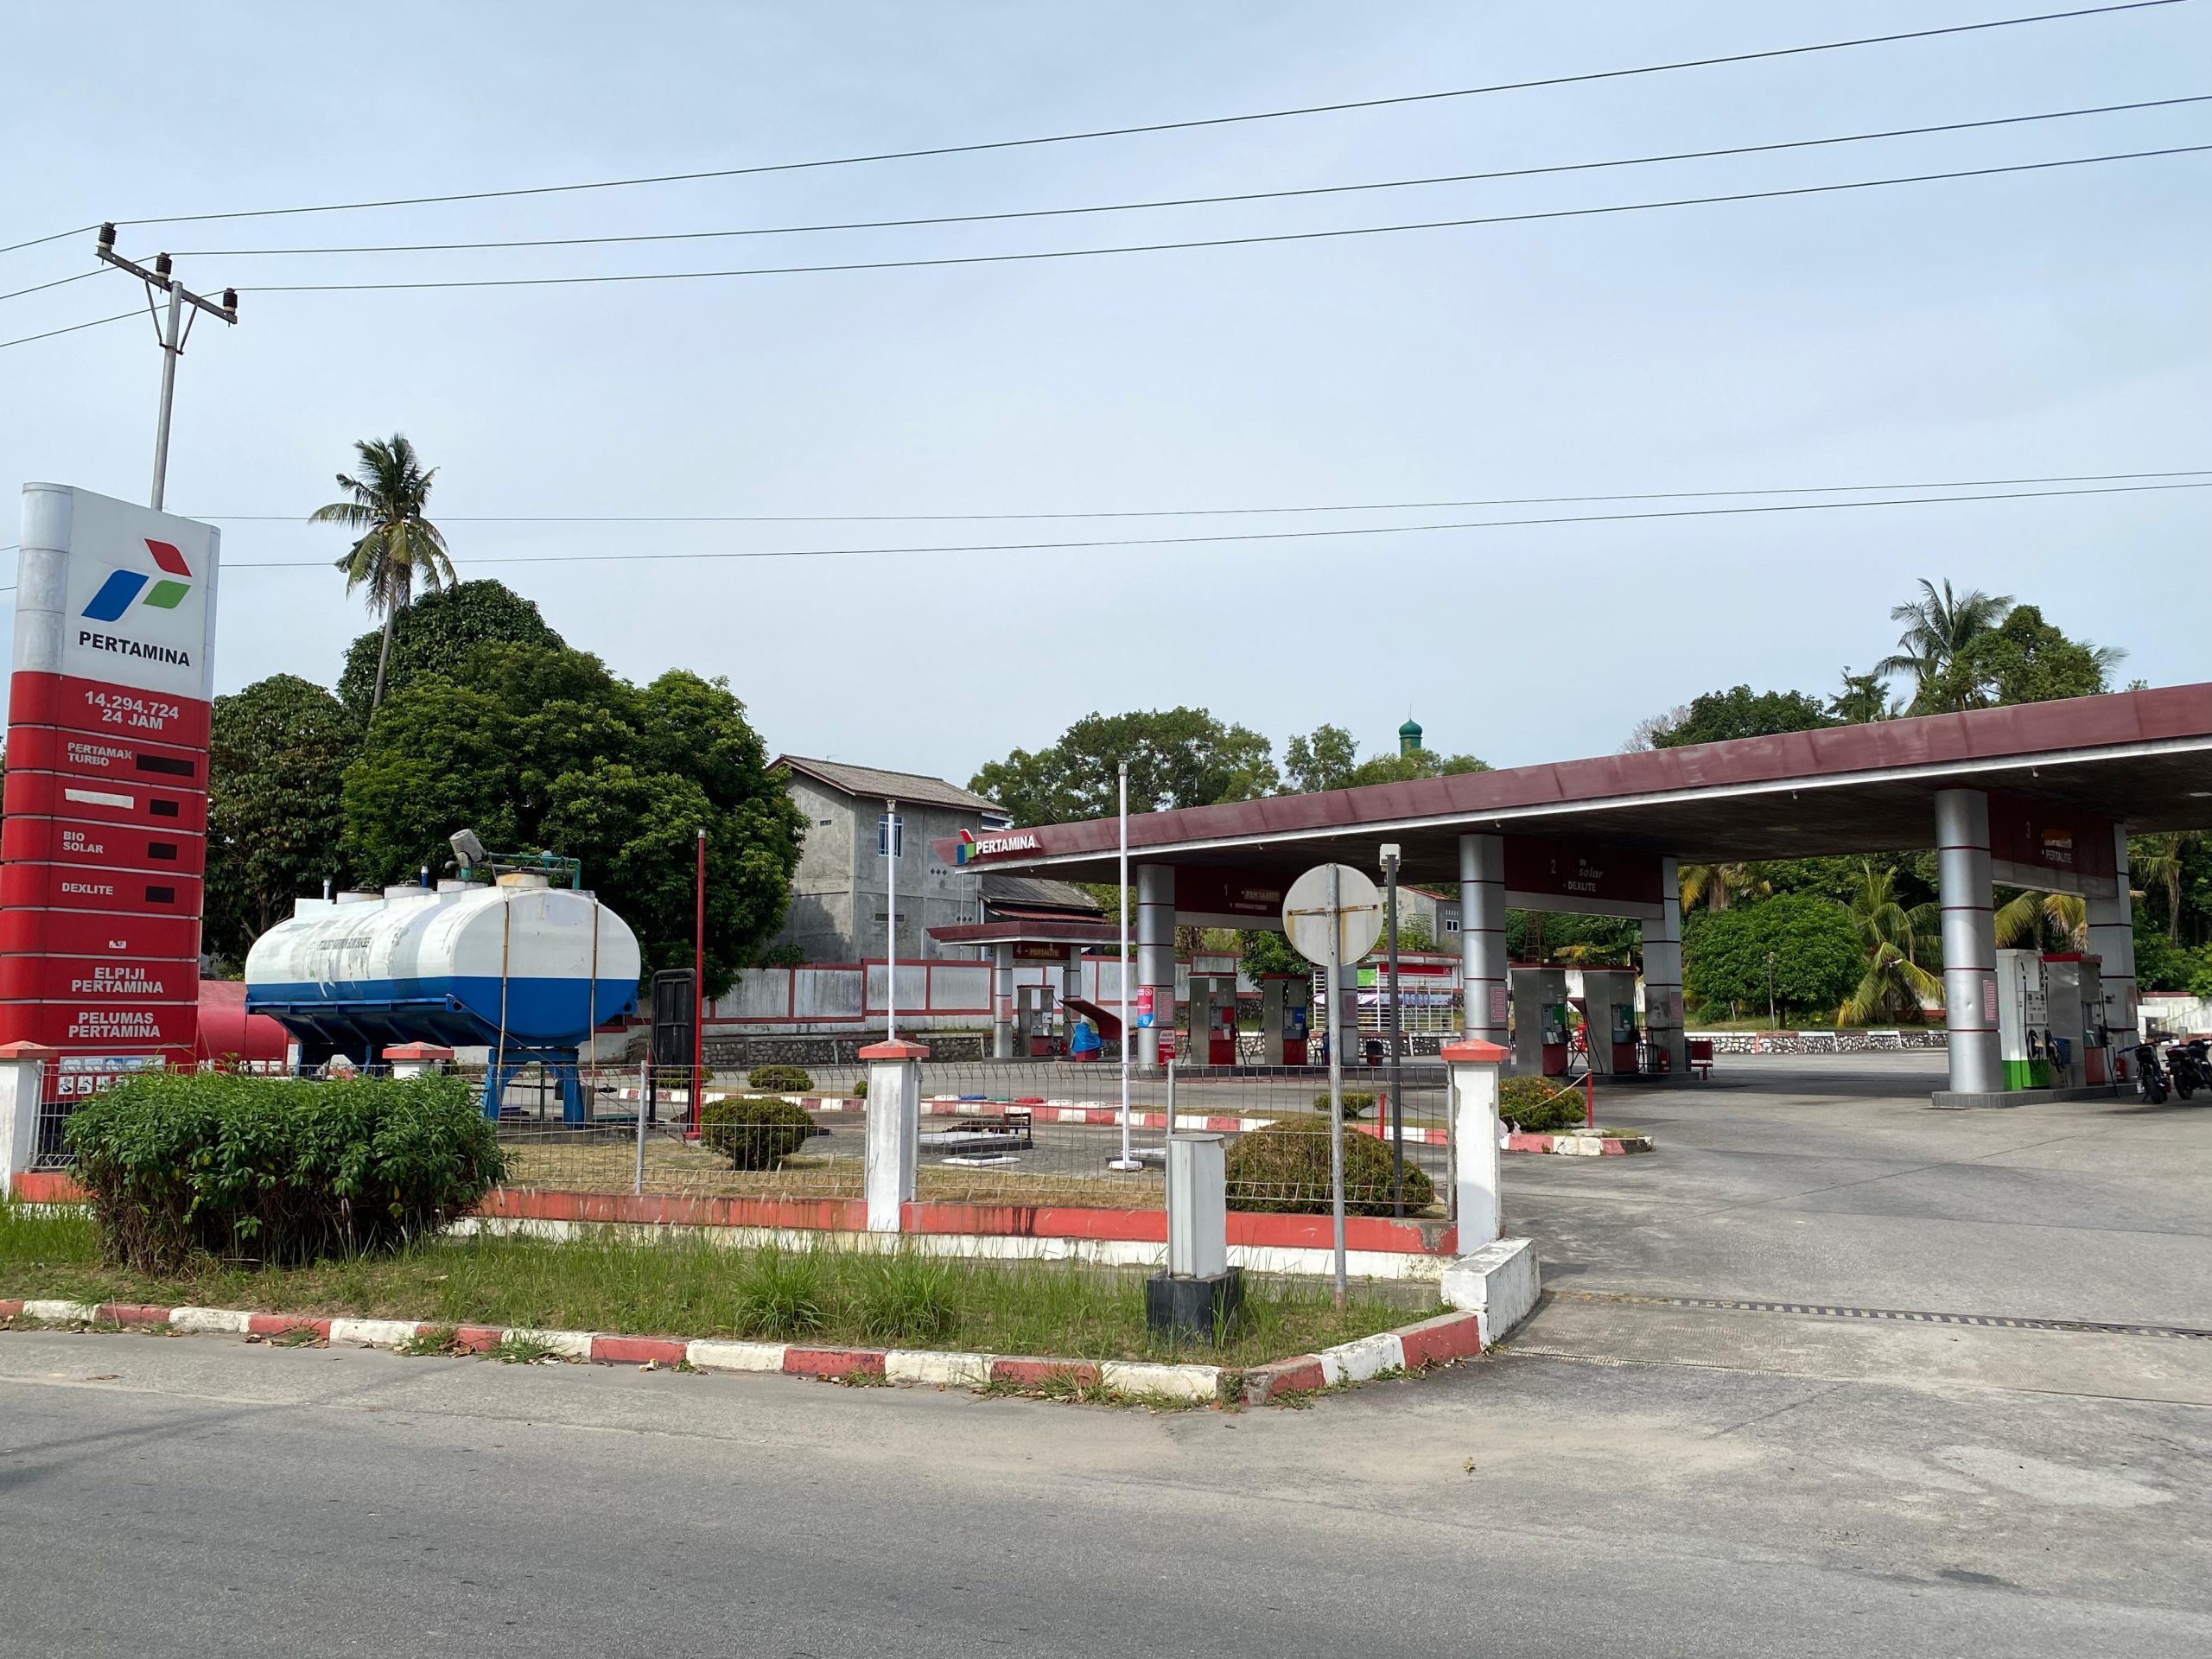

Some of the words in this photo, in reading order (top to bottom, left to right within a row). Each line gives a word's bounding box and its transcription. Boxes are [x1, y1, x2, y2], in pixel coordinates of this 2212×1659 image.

[79, 631, 190, 667] PERTAMINA
[85, 691, 180, 719] 14.294.724
[102, 709, 122, 724] 24
[127, 714, 163, 730] JAM
[67, 741, 132, 760] PERTAMAX
[68, 753, 110, 767] TURBO
[63, 830, 85, 842] BIO
[2025, 821, 2031, 839] 3
[62, 842, 104, 855] SOLAR
[976, 835, 1035, 855] PERTAMINA
[2045, 849, 2072, 864] PERTALITE
[1550, 859, 1556, 874] 2
[61, 882, 114, 895] DEXLITE
[1567, 880, 1597, 892] DEXLITE
[1244, 890, 1281, 900] PERTALITE
[94, 967, 145, 981] ELPIJI
[72, 980, 163, 994] PERTAMINA
[79, 1012, 154, 1025] PELUMAS
[68, 1025, 161, 1038] PERTAMINA
